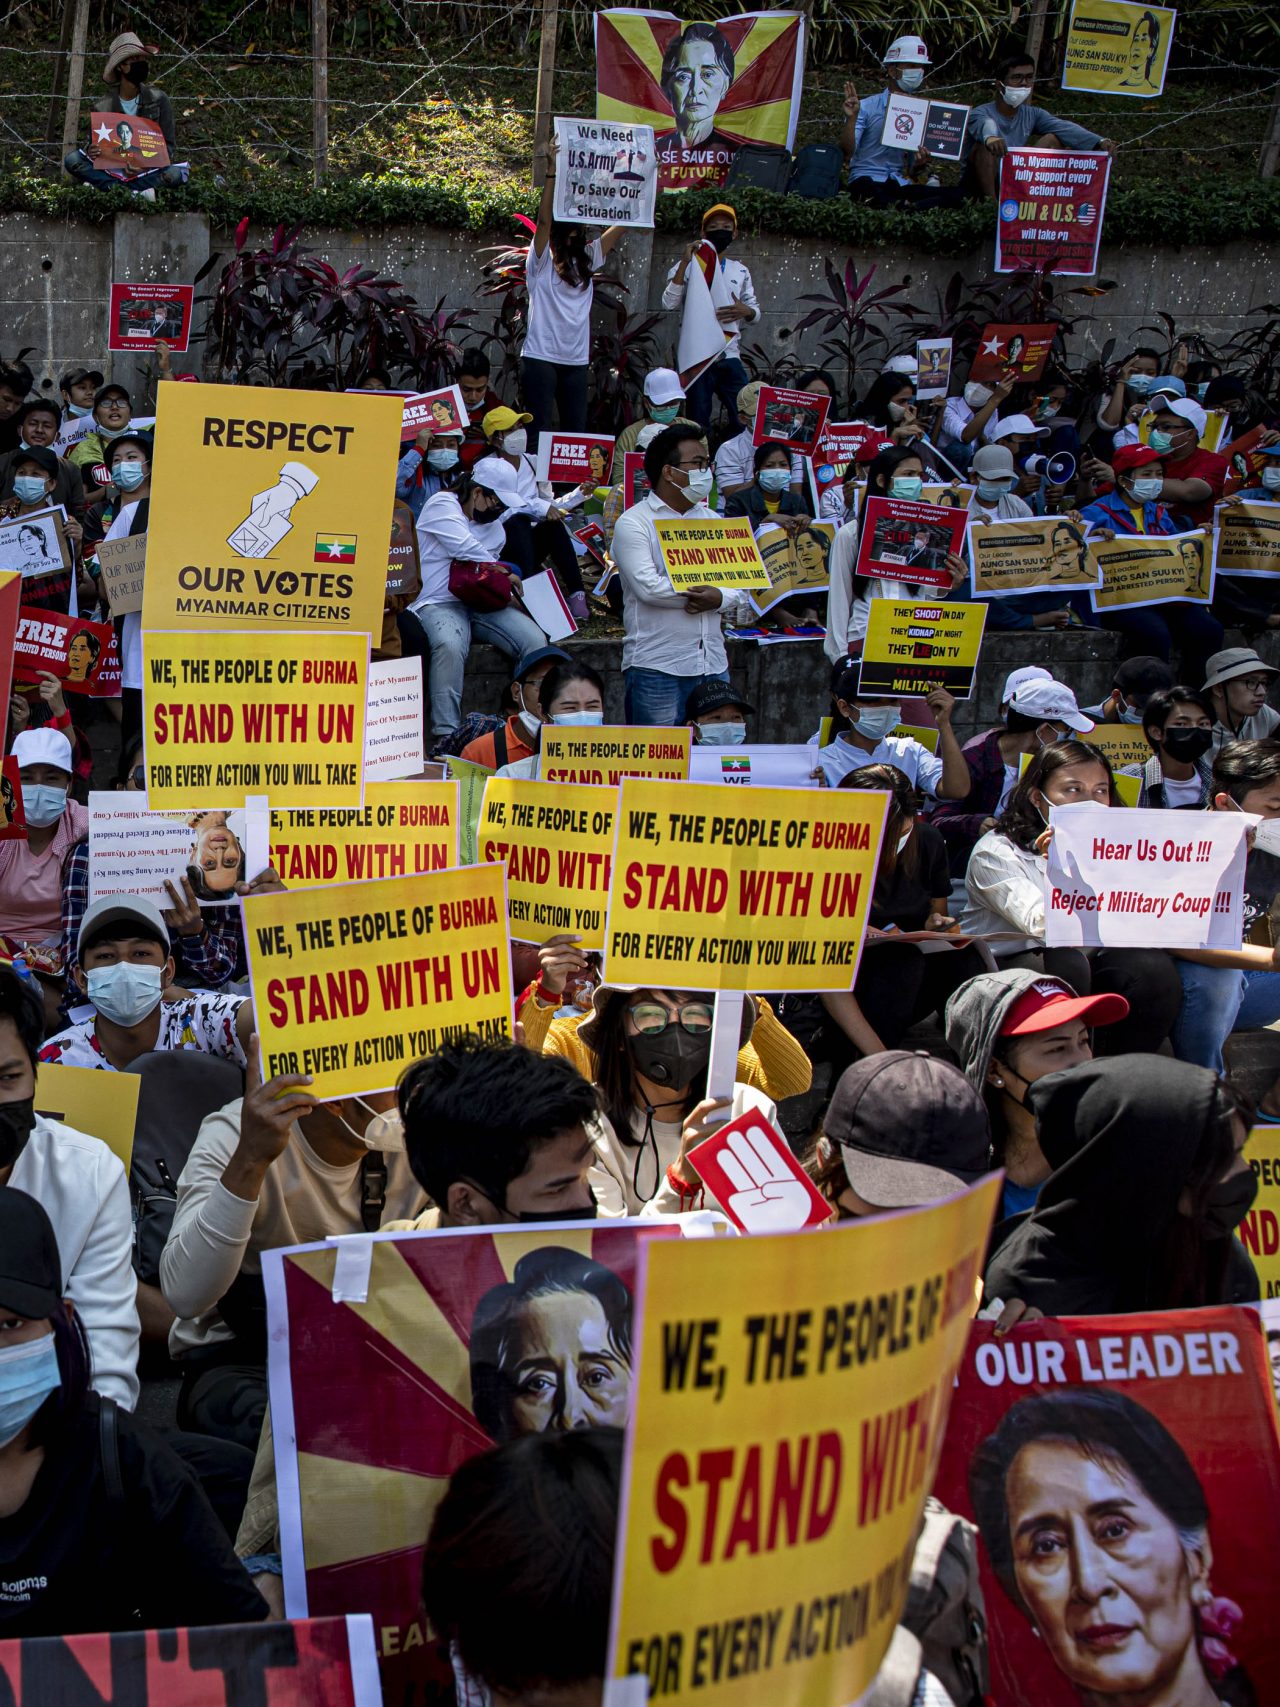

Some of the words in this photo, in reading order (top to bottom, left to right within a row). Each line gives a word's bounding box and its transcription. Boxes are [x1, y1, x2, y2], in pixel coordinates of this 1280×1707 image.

[578, 126, 598, 140] We
[602, 128, 634, 142] Need
[682, 150, 714, 164] SAVE
[1028, 156, 1066, 168] Myanmar
[670, 166, 720, 180] FUTURE
[1015, 169, 1033, 182] fully
[1034, 172, 1066, 184] support
[1068, 174, 1092, 184] every
[572, 182, 585, 194] To
[588, 184, 616, 197] Save
[620, 186, 640, 198] Our
[577, 205, 631, 220] Situation
[1018, 202, 1038, 221] UN
[1040, 204, 1048, 222] &
[204, 417, 354, 456] RESPECT
[552, 442, 587, 458] FREE
[660, 530, 674, 542] WE,
[674, 530, 688, 541] THE
[688, 529, 714, 540] PEOPLE
[715, 529, 724, 540] OF
[724, 528, 750, 540] BURMA
[666, 548, 705, 566] STAND
[705, 546, 738, 564] WITH
[737, 546, 758, 563] UN
[980, 560, 1003, 570] AUNG
[1004, 560, 1021, 568] SAN
[1022, 558, 1038, 566] SUU
[178, 566, 246, 593] OUR
[254, 570, 354, 599] VOTES
[1116, 580, 1154, 592] ARRESTED
[1156, 577, 1186, 586] PERSONS
[176, 598, 268, 618] MYANMAR
[272, 603, 351, 621] CITIZENS
[894, 608, 914, 618] THEY
[914, 608, 942, 619] SHOOT
[942, 610, 950, 618] IN
[950, 610, 966, 620] DAY
[17, 618, 68, 648] FREE
[890, 627, 908, 636] THEY
[908, 626, 934, 637] KIDNAP
[944, 630, 963, 638] NIGHT
[888, 644, 914, 654] THEY
[932, 646, 946, 657] ON
[947, 647, 960, 658] TV
[150, 660, 178, 689] WE,
[181, 660, 214, 684] THE
[218, 660, 274, 684] PEOPLE
[276, 660, 298, 684] OF
[302, 660, 358, 684] BURMA
[387, 674, 418, 686] Myanmar
[154, 704, 234, 746] STAND
[243, 704, 311, 744] WITH
[318, 704, 354, 744] UN
[369, 736, 390, 746] Elected
[390, 730, 420, 745] President
[378, 753, 402, 766] Military
[403, 750, 420, 762] Coup
[150, 765, 174, 788] FOR
[176, 764, 214, 788] EVERY
[216, 764, 262, 787] ACTION
[265, 764, 291, 786] YOU
[293, 764, 322, 786] WILL
[326, 764, 357, 786] TAKE
[628, 810, 660, 845] WE,
[669, 814, 704, 844] THE
[710, 816, 780, 848] PEOPLE
[785, 821, 810, 849] OF
[812, 822, 872, 850] BURMA
[1092, 837, 1132, 862] Hear
[1137, 840, 1157, 862] Us
[1162, 840, 1193, 862] Out
[1196, 840, 1212, 862] !!!
[624, 862, 728, 914] STAND
[739, 870, 813, 917] WITH
[820, 872, 862, 919] UN
[1051, 888, 1105, 916] Reject
[1107, 891, 1170, 918] Military
[1172, 892, 1211, 919] Coup
[1214, 892, 1232, 914] !!!
[256, 925, 293, 960] WE,
[296, 919, 334, 951] THE
[339, 910, 408, 946] PEOPLE
[412, 905, 434, 935] OF
[439, 896, 498, 932] BURMA
[266, 968, 370, 1028] STAND
[376, 954, 453, 1012] WITH
[461, 947, 500, 999] UN
[661, 1319, 728, 1404] WE,
[745, 1310, 812, 1385] THE
[818, 1284, 918, 1374] PEOPLE
[975, 1340, 1068, 1387] OUR
[1076, 1331, 1244, 1382] LEADER
[651, 1430, 842, 1574] STAND
[691, 1608, 784, 1689] EVERY
